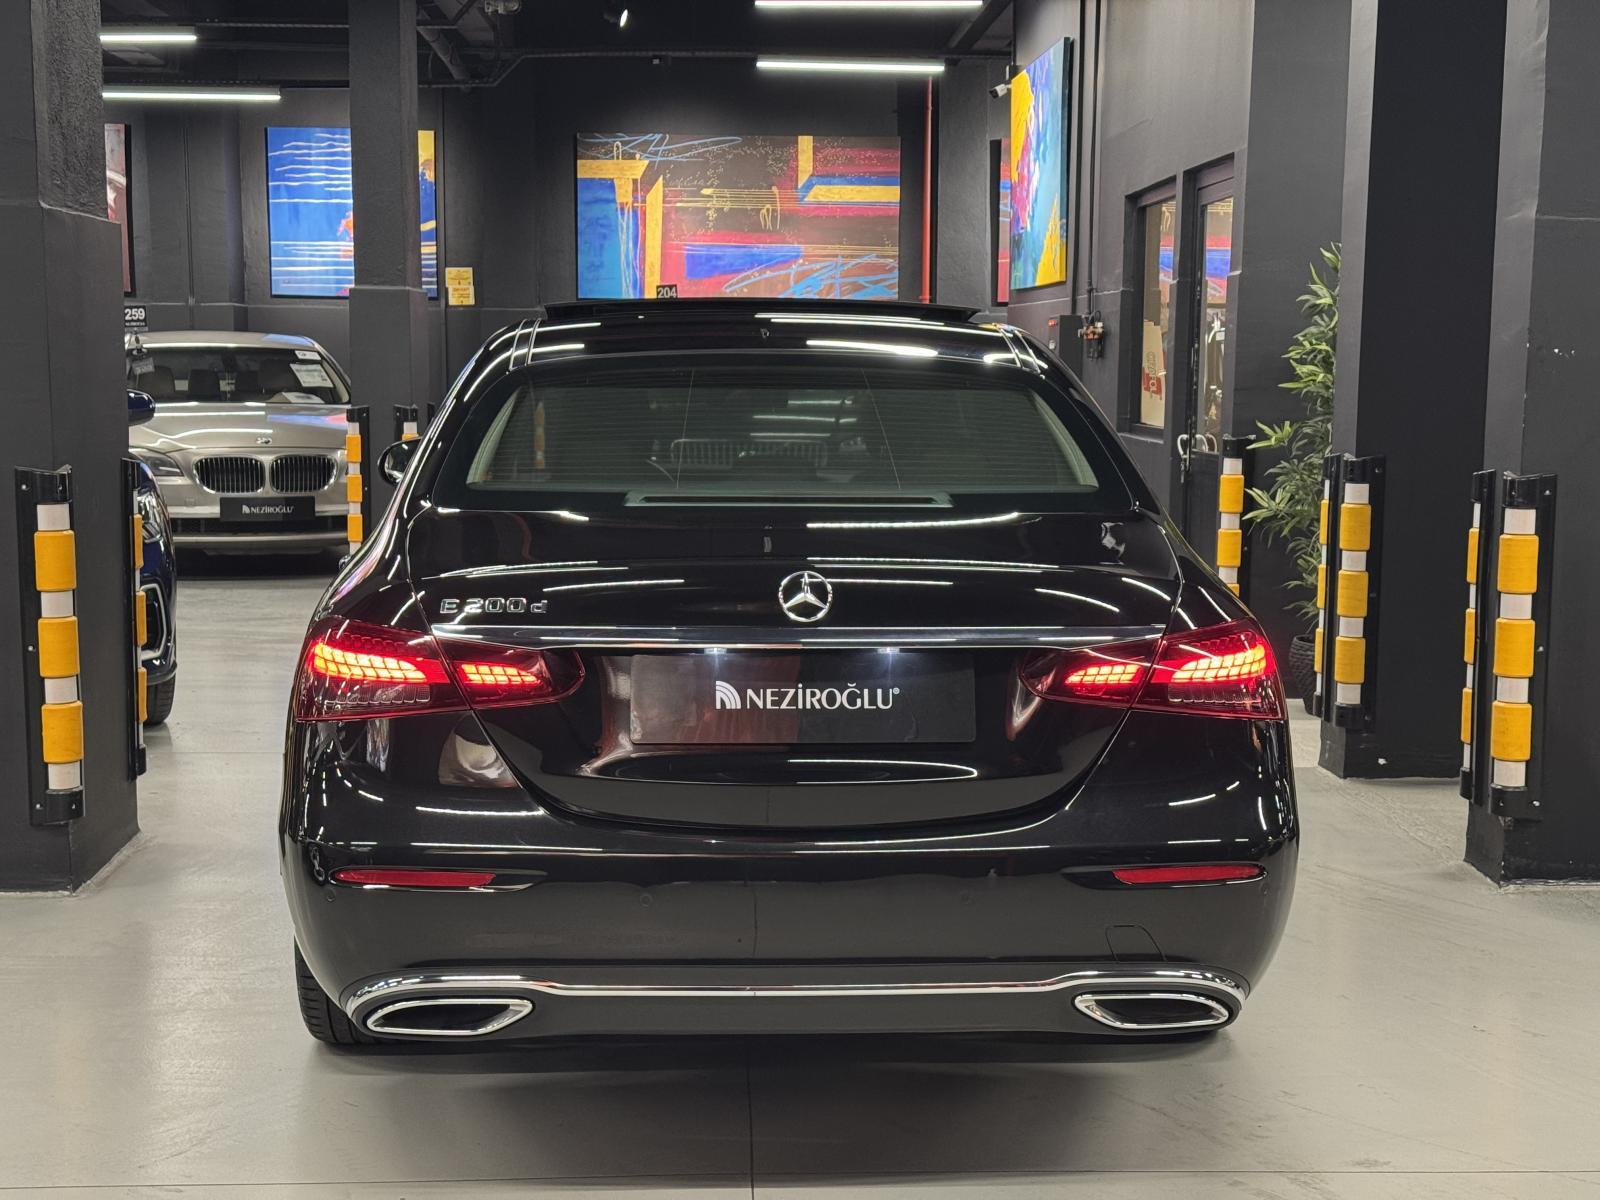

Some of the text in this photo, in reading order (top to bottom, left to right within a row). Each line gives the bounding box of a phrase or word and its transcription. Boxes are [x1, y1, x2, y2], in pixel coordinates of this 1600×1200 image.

[657, 286, 676, 298] 204
[124, 308, 145, 320] 259
[440, 597, 548, 613] E 200 d
